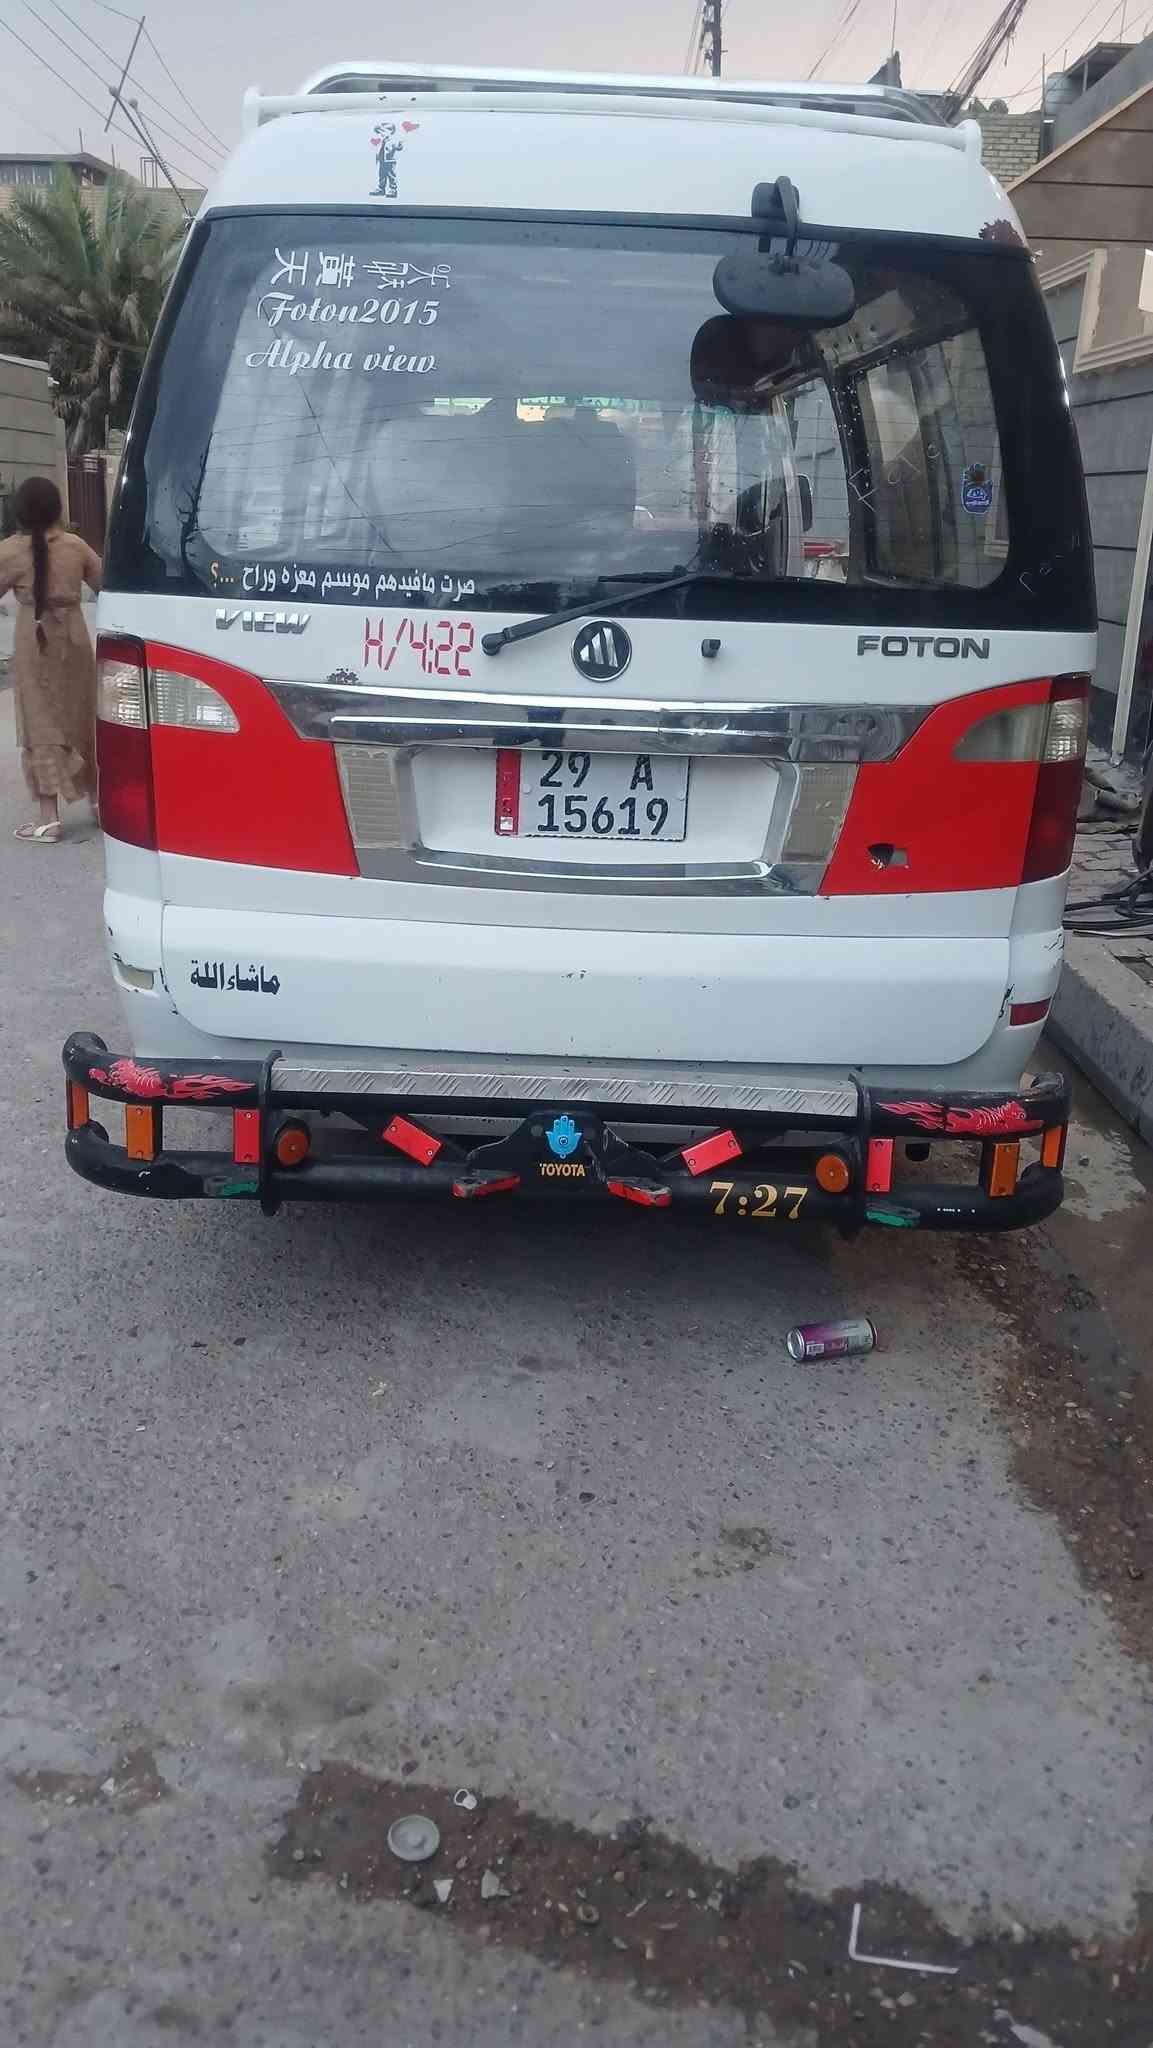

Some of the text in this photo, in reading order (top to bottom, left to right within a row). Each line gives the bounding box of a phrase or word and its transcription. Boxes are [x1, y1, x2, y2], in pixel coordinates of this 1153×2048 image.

[257, 292, 440, 328] Foton2015
[246, 339, 437, 376] Alpha view
[215, 609, 311, 635] VIEW
[857, 635, 990, 659] FOTON
[540, 752, 653, 791] 29 A
[537, 793, 669, 836] 15619
[540, 1163, 586, 1177] TOYOTA
[710, 1181, 809, 1219] 7:27
